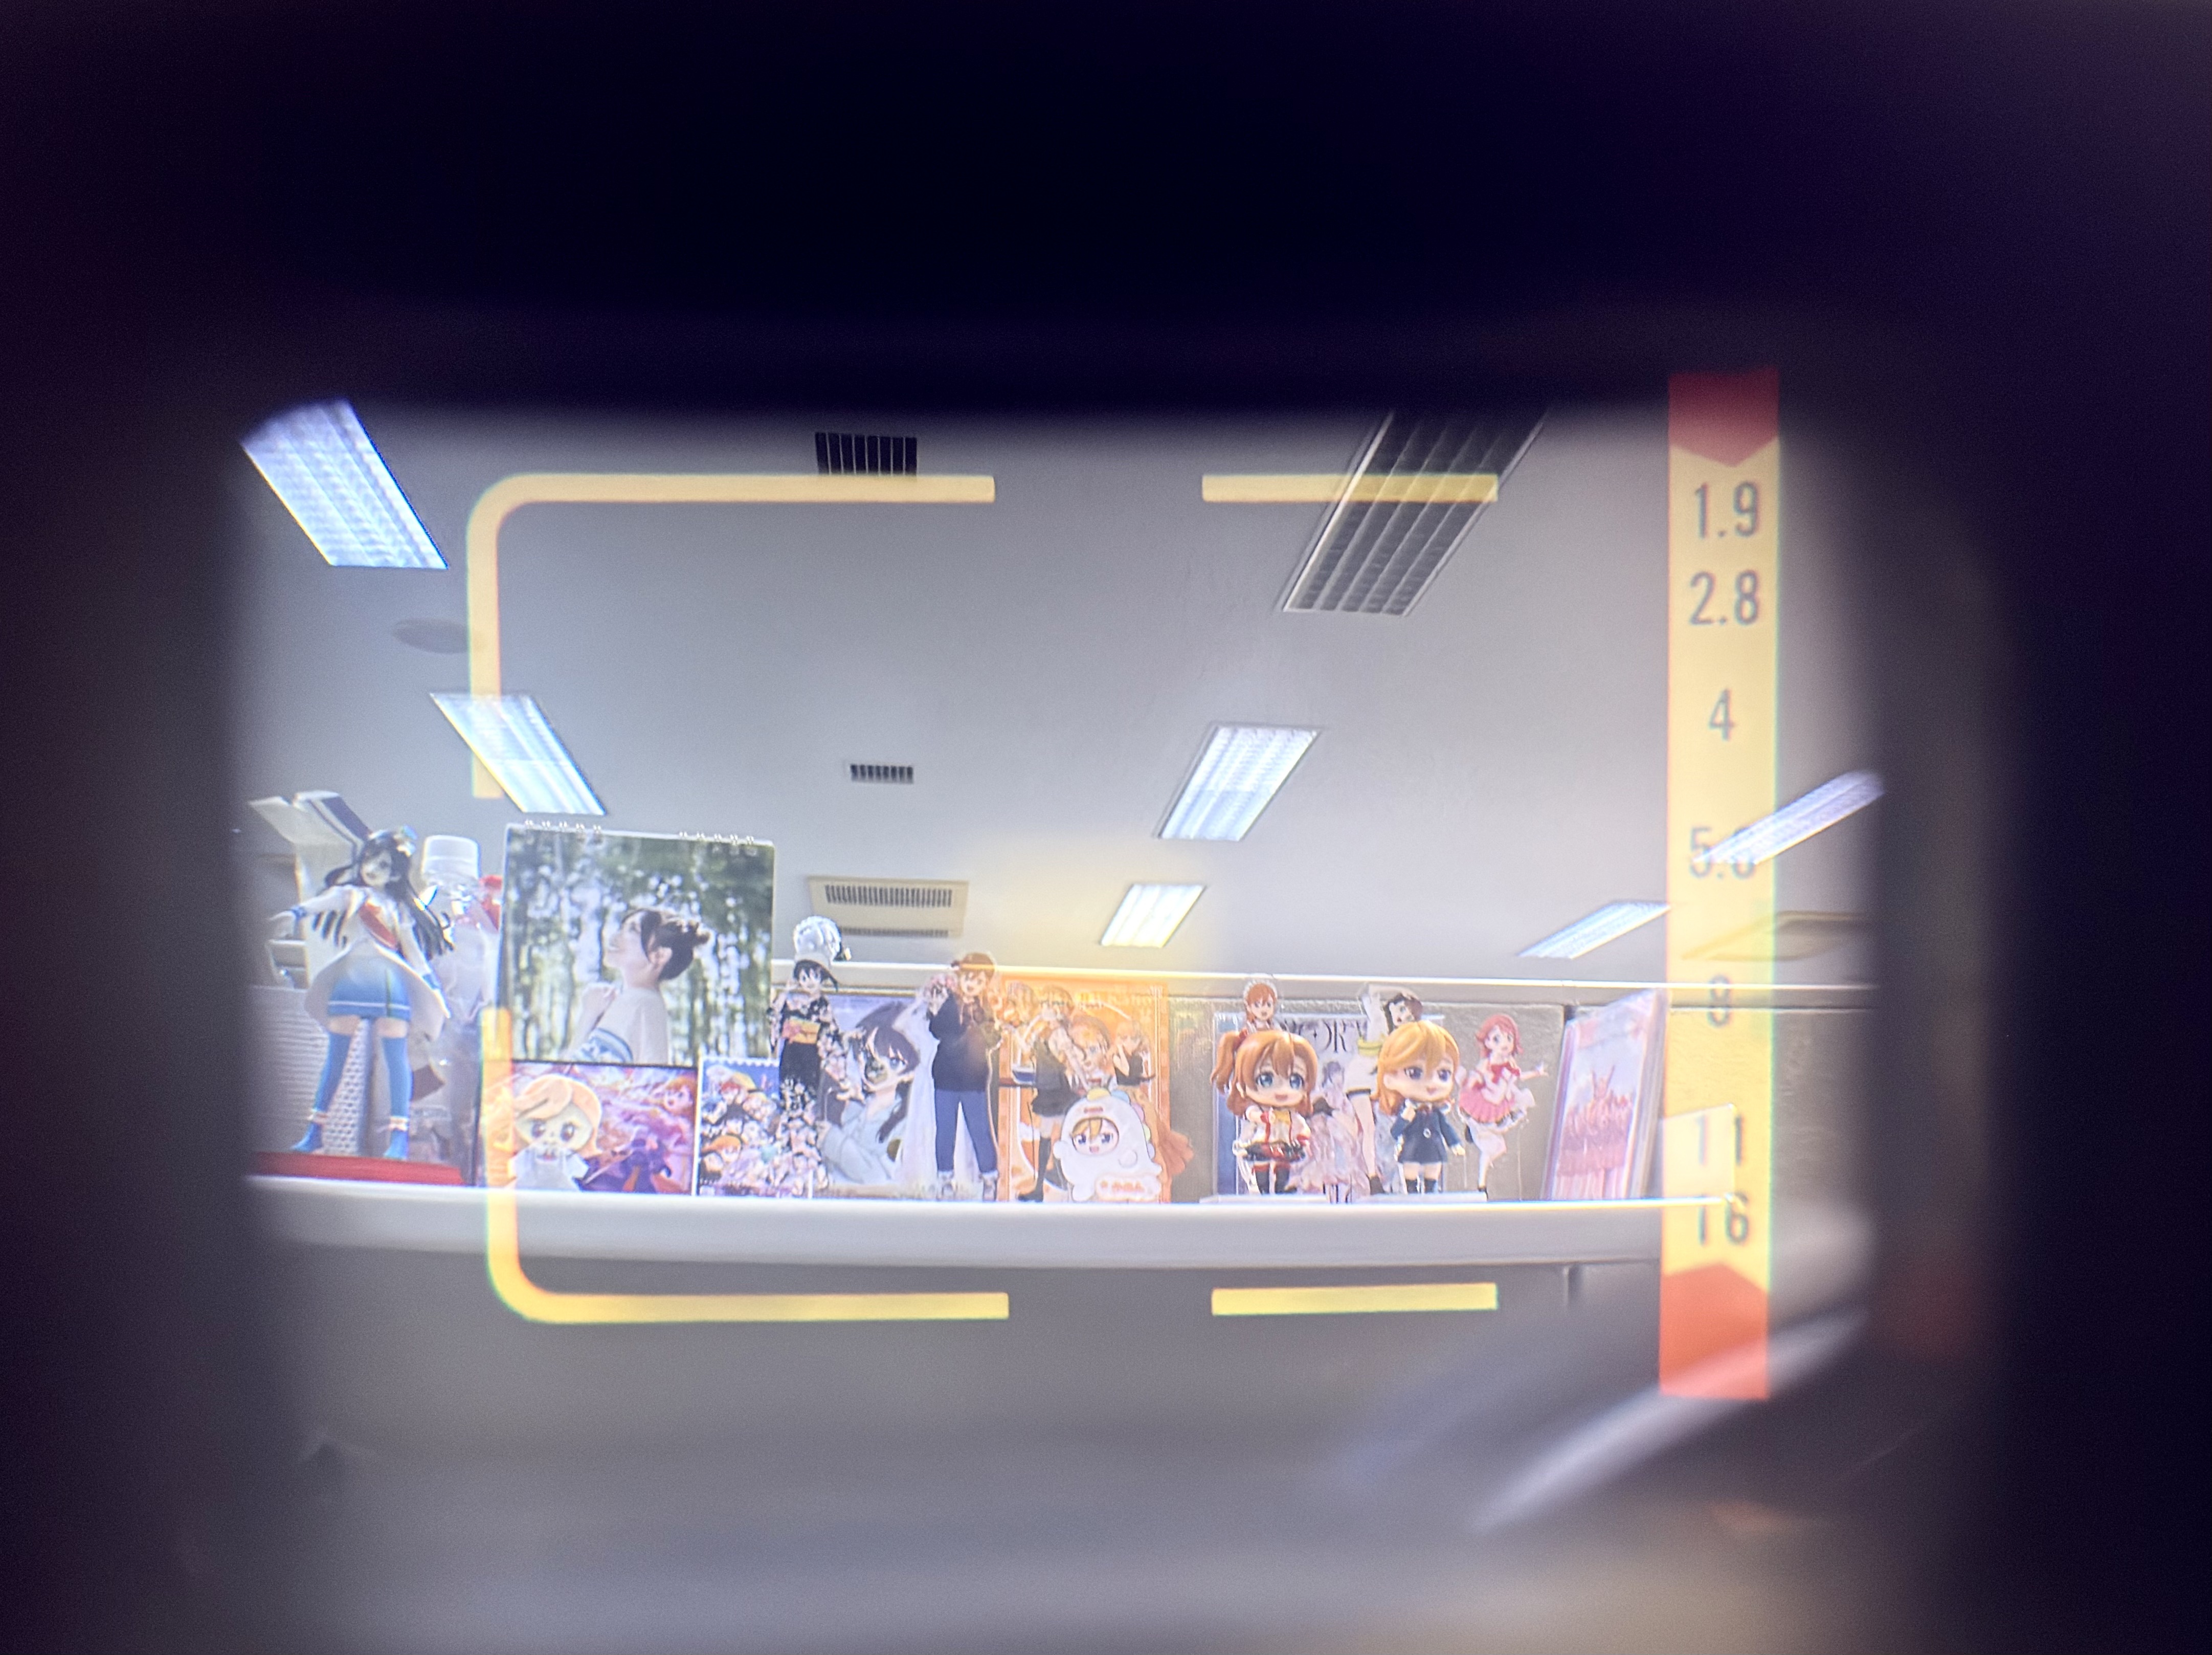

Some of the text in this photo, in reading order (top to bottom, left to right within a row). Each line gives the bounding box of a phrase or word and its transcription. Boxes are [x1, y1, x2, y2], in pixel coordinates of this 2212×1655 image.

[1694, 481, 1760, 539] 1.9
[1689, 569, 1759, 626] 2.8
[1708, 689, 1735, 741] 4
[1707, 974, 1732, 1028] 8
[1695, 1114, 1746, 1166] 11
[1697, 1191, 1749, 1246] 16
